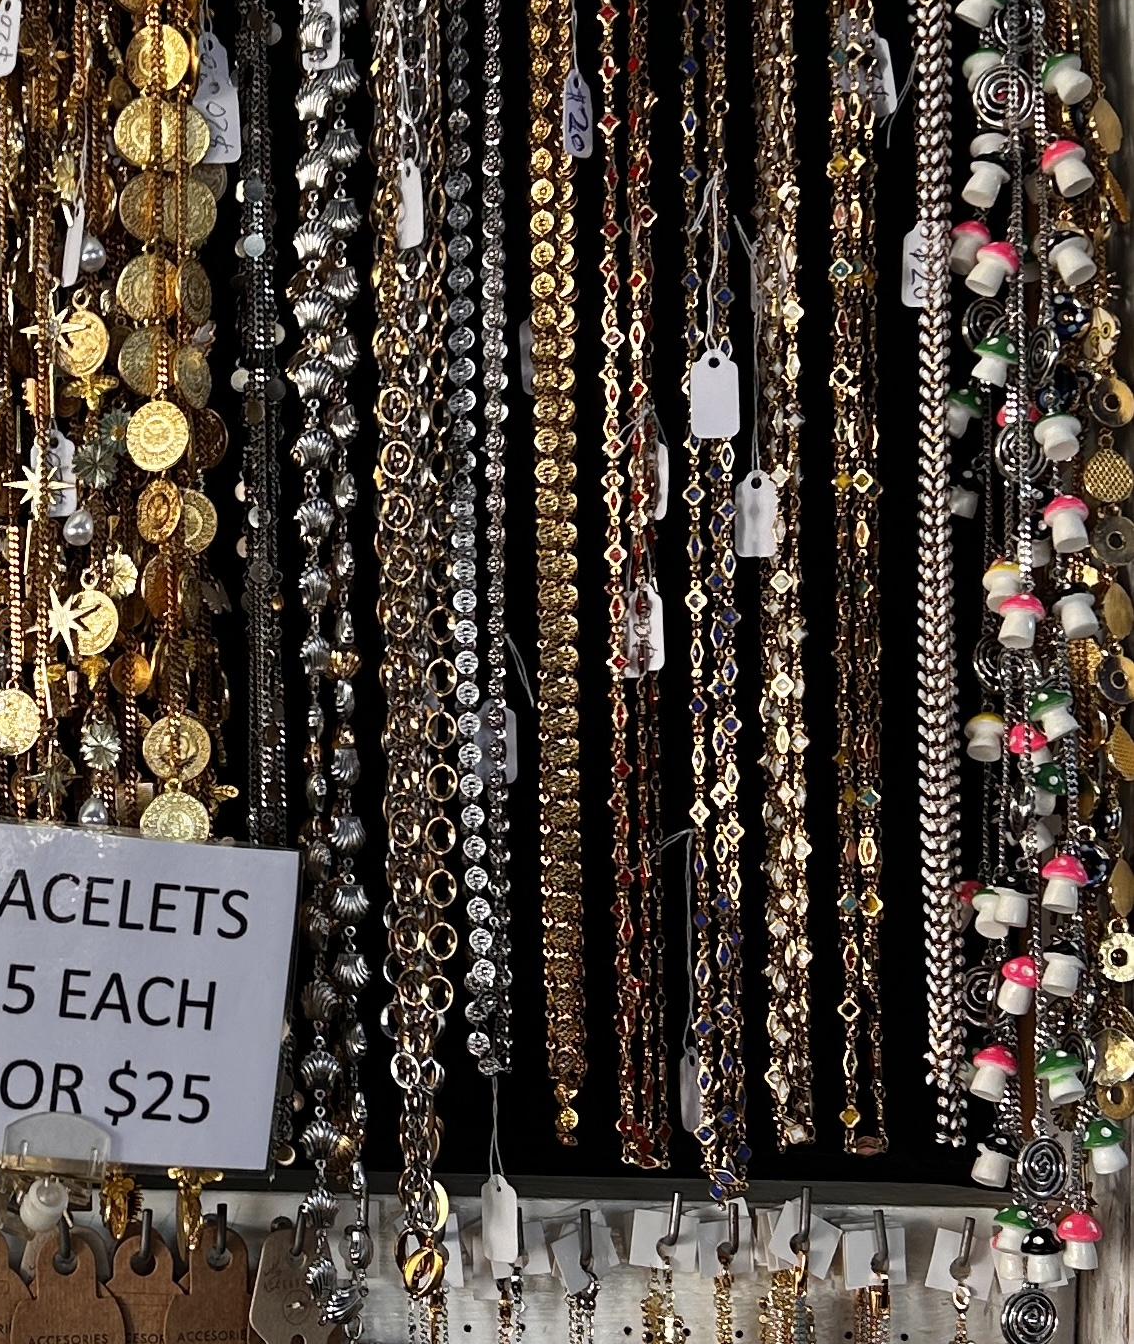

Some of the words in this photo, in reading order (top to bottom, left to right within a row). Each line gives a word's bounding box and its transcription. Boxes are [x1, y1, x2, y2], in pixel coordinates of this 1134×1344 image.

[206, 101, 234, 154] $20
[58, 968, 217, 1031] EACH
[103, 1059, 211, 1126] $25
[125, 1332, 164, 1344] CESOR
[176, 1328, 246, 1343] ACCESORIE
